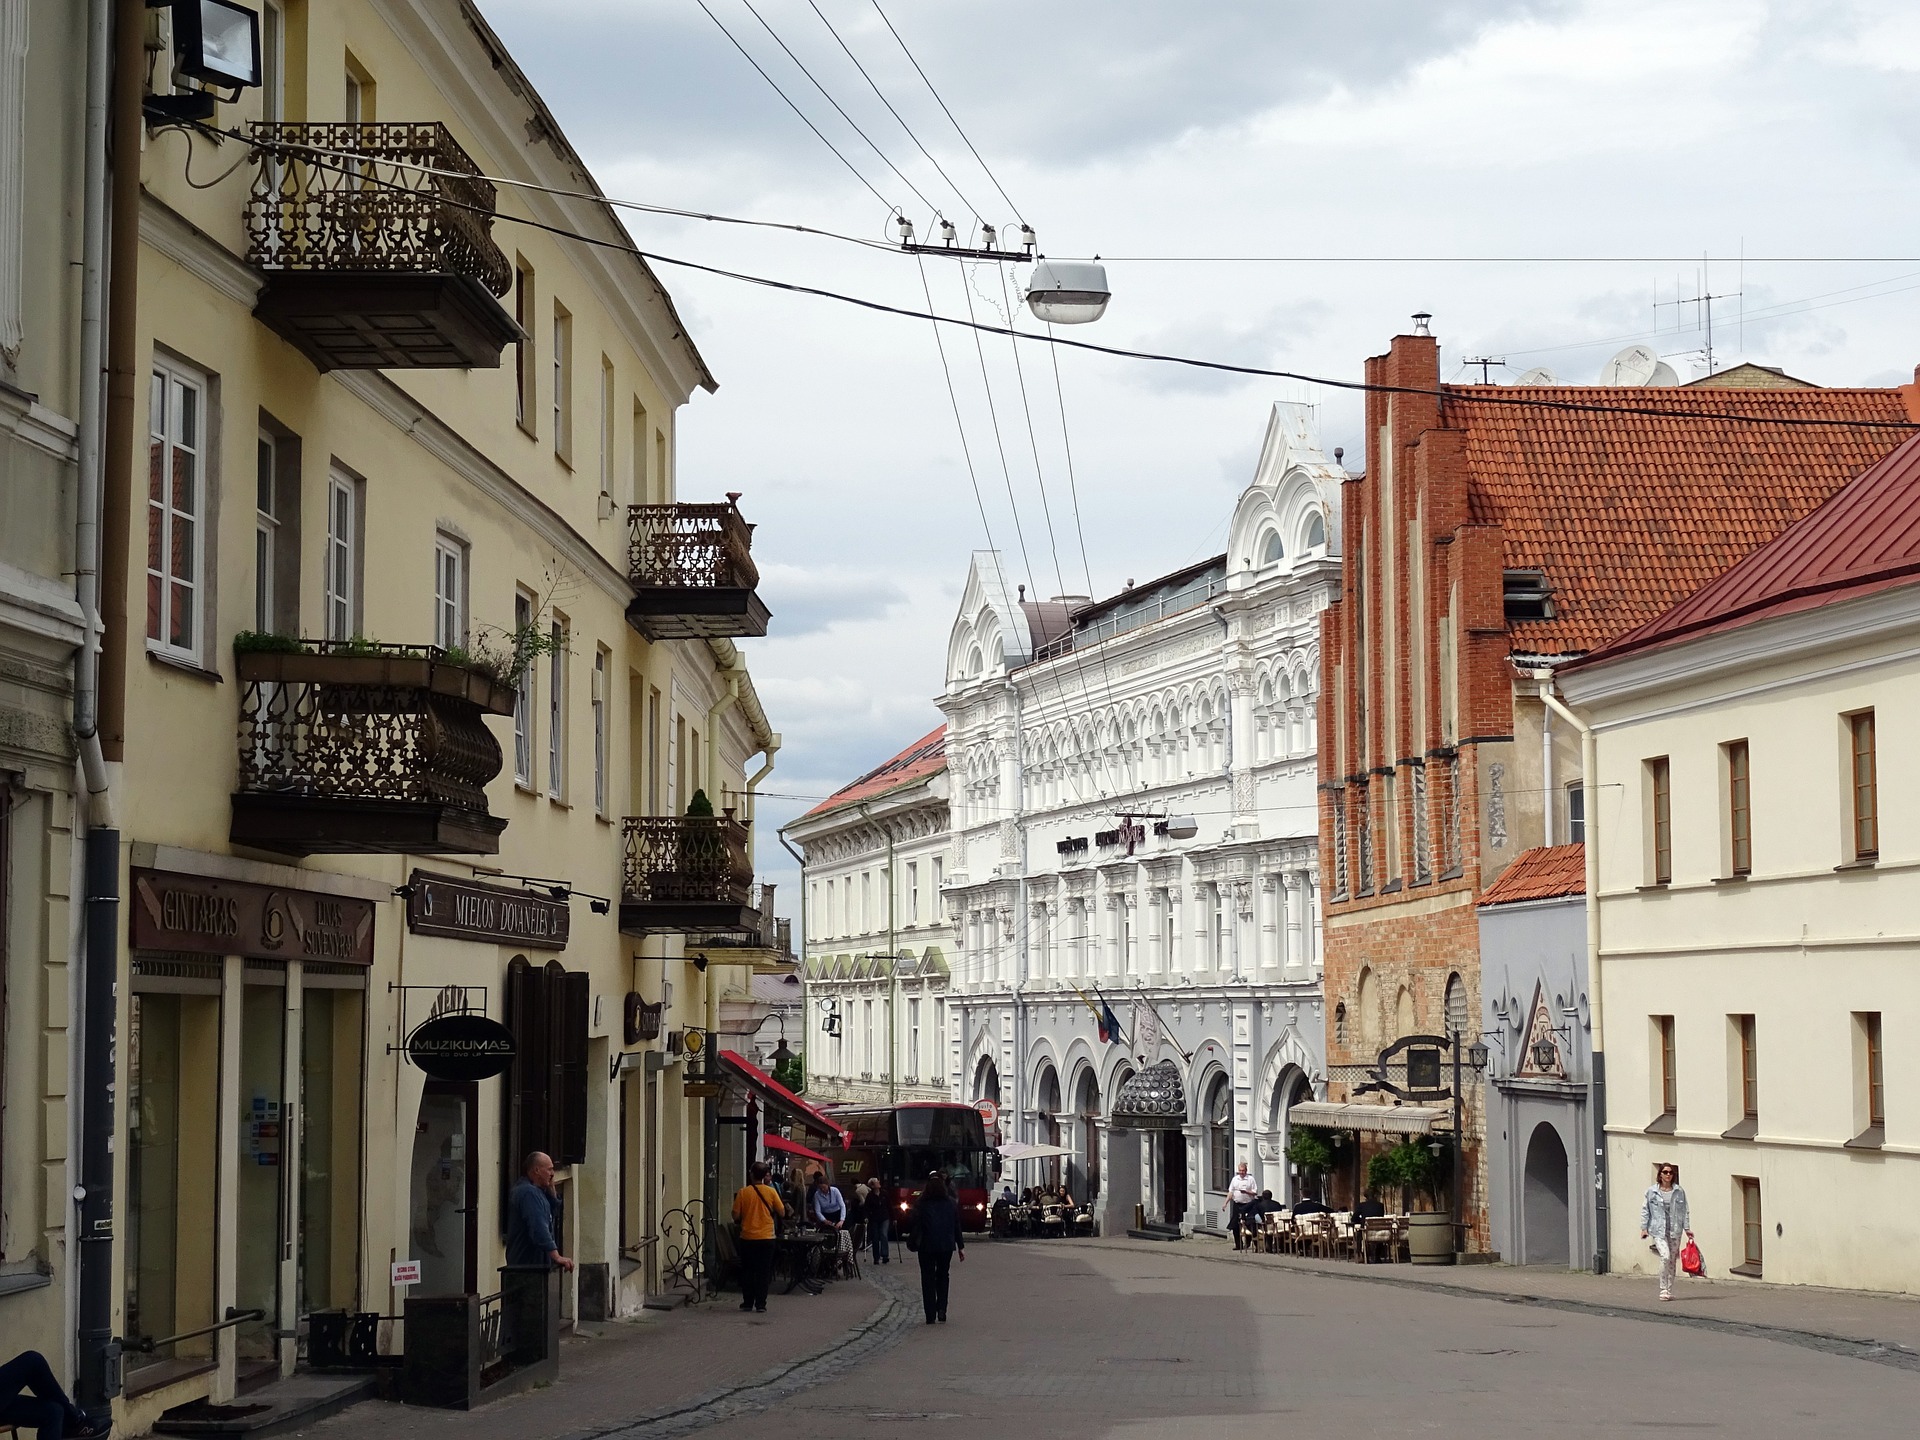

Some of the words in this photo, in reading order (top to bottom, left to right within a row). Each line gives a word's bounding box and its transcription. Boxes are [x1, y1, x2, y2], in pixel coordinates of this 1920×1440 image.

[162, 889, 239, 937] GINTARAS
[316, 901, 343, 928] LINAS
[455, 894, 495, 929] MIELOS
[500, 902, 549, 937] DOVANĖLĖS
[304, 929, 354, 958] SUVENYRAI
[414, 1039, 511, 1051] MUZIKUMAS
[1140, 1118, 1168, 1127] HOTEL
